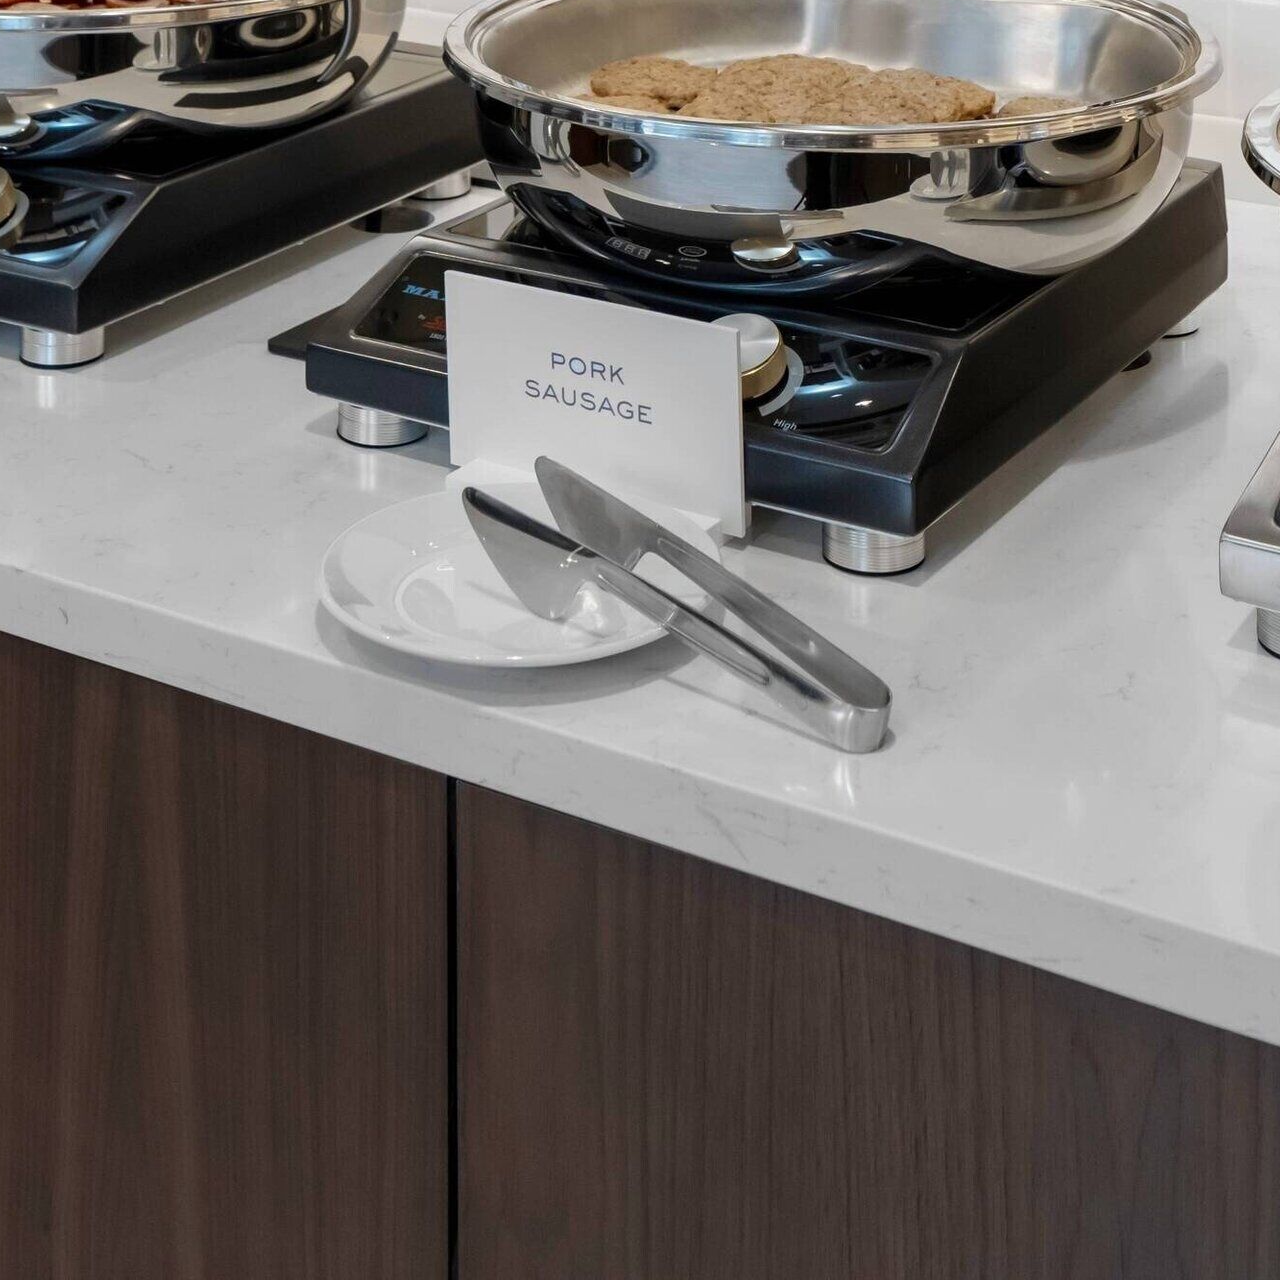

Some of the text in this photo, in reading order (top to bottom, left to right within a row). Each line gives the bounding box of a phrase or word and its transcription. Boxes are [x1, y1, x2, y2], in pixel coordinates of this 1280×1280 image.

[551, 351, 625, 385] PORK
[524, 380, 653, 424] SAUSAGE
[773, 418, 797, 431] High
